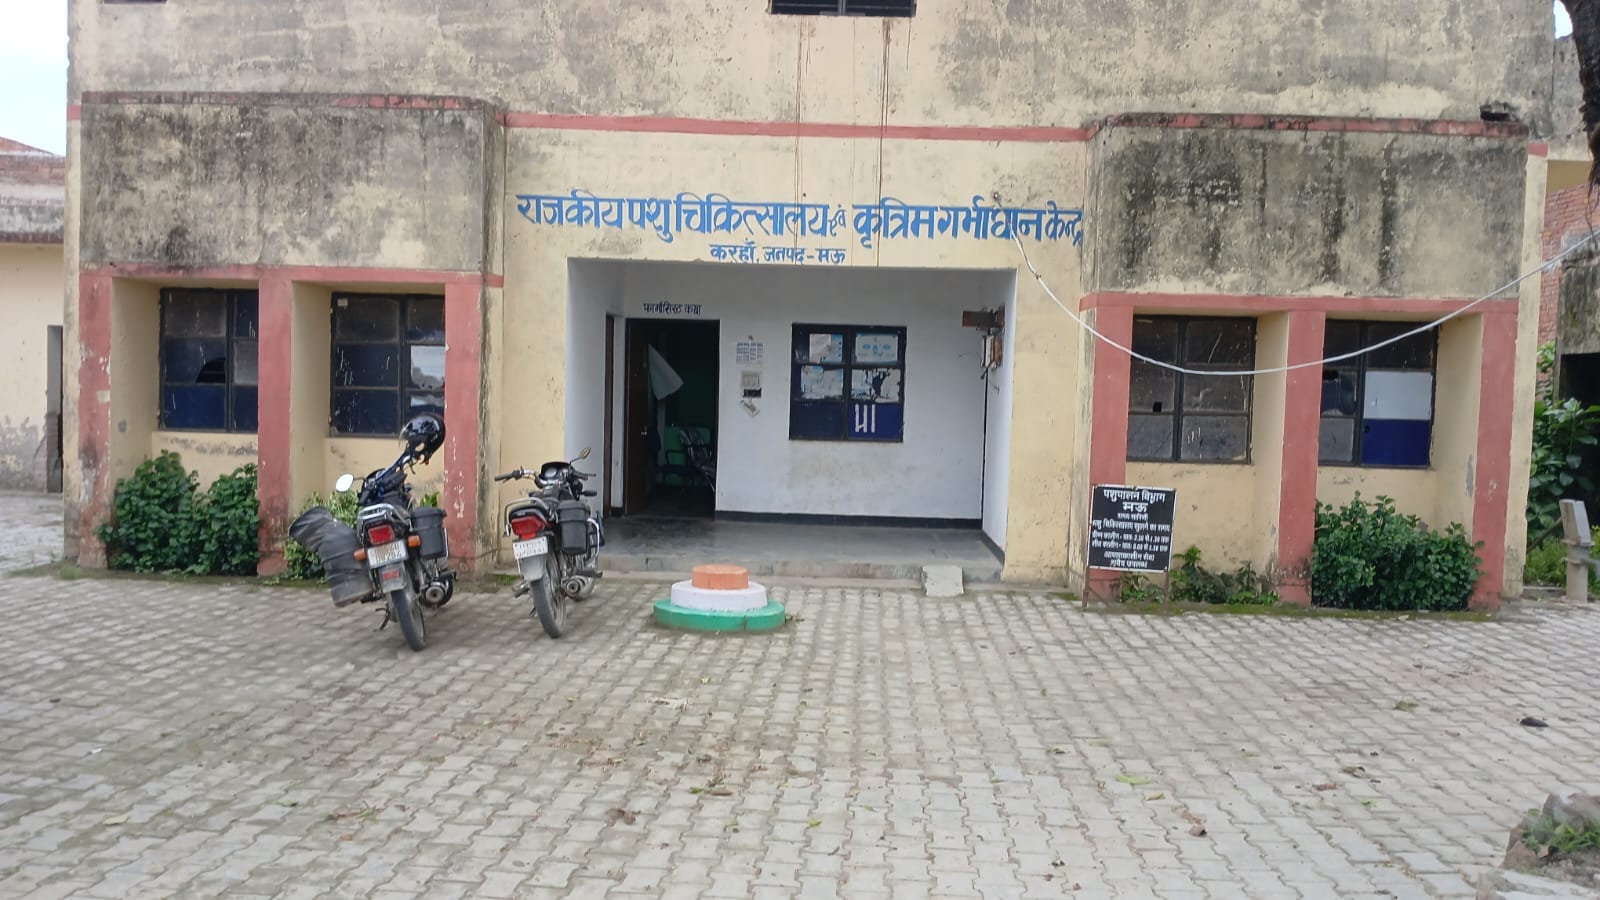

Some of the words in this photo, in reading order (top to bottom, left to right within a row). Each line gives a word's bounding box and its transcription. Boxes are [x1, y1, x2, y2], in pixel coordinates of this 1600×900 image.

[515, 188, 625, 231] राजकीय
[625, 197, 674, 243] पशु
[852, 196, 937, 248] कृत्रिम
[937, 195, 1043, 242] गर्भाधान
[1045, 200, 1083, 247] केन्द्र
[1103, 489, 1140, 503] पशुपालन
[1141, 489, 1166, 504] विभाग
[1122, 501, 1149, 512] मऊ
